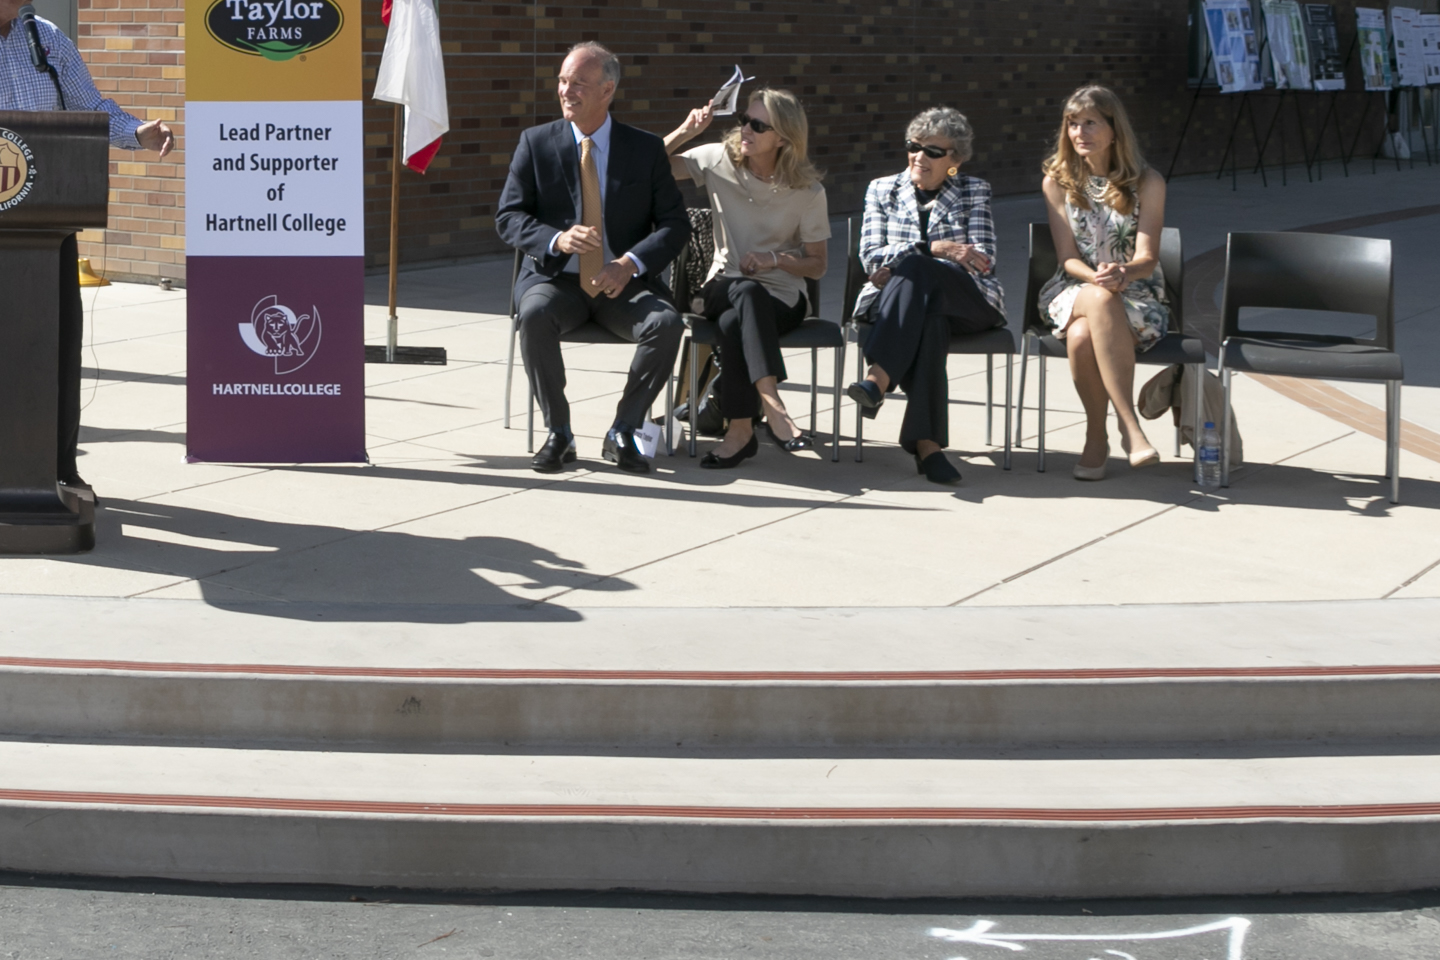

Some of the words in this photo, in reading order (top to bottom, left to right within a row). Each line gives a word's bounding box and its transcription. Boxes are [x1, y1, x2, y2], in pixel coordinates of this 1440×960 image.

[247, 27, 303, 40] FARMS
[219, 123, 260, 141] Lead
[265, 123, 332, 141] Partner
[2, 130, 34, 161] COLLEGE
[212, 153, 245, 171] and
[250, 153, 339, 175] Supporter
[266, 183, 285, 201] of
[205, 213, 278, 231] Hartnell
[282, 213, 347, 236] College
